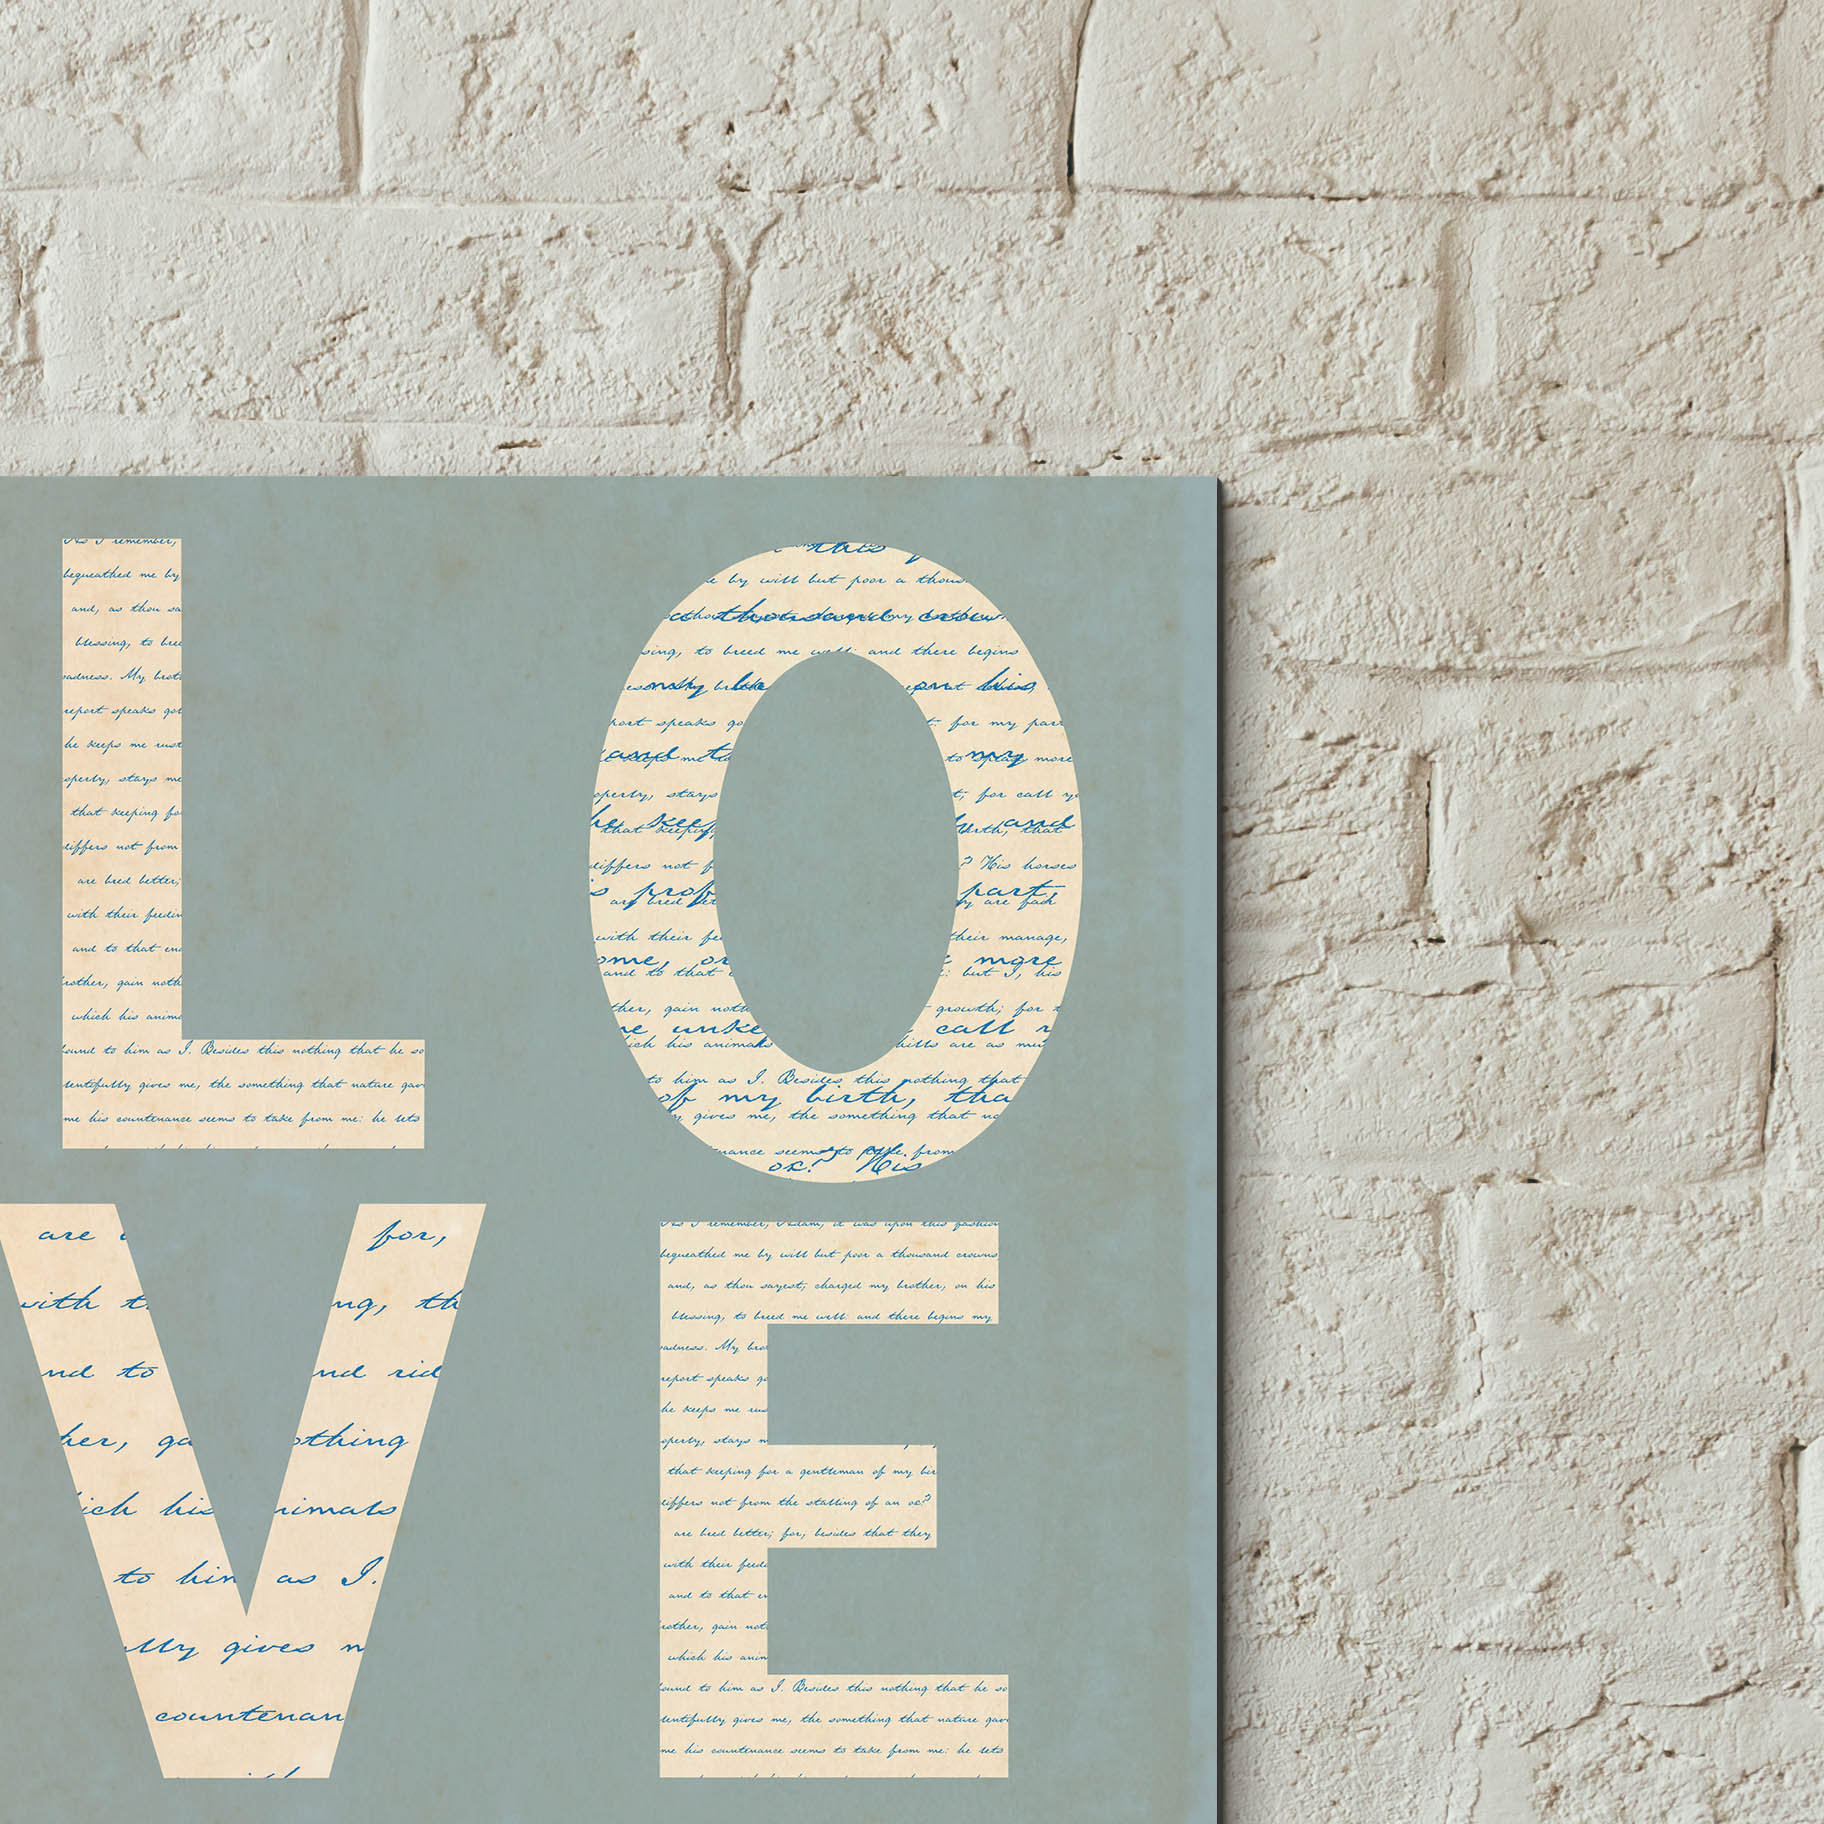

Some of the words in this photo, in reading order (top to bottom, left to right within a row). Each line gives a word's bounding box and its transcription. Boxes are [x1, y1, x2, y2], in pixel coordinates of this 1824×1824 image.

[935, 1018, 1016, 1036] call
[805, 1084, 915, 1109] birth,
[37, 1231, 95, 1241] are
[365, 1219, 447, 1252] for,
[115, 1360, 160, 1379] to
[111, 1566, 155, 1585] to
[276, 1574, 318, 1585] as
[340, 1555, 385, 1587] I.
[219, 1634, 316, 1665] gives
